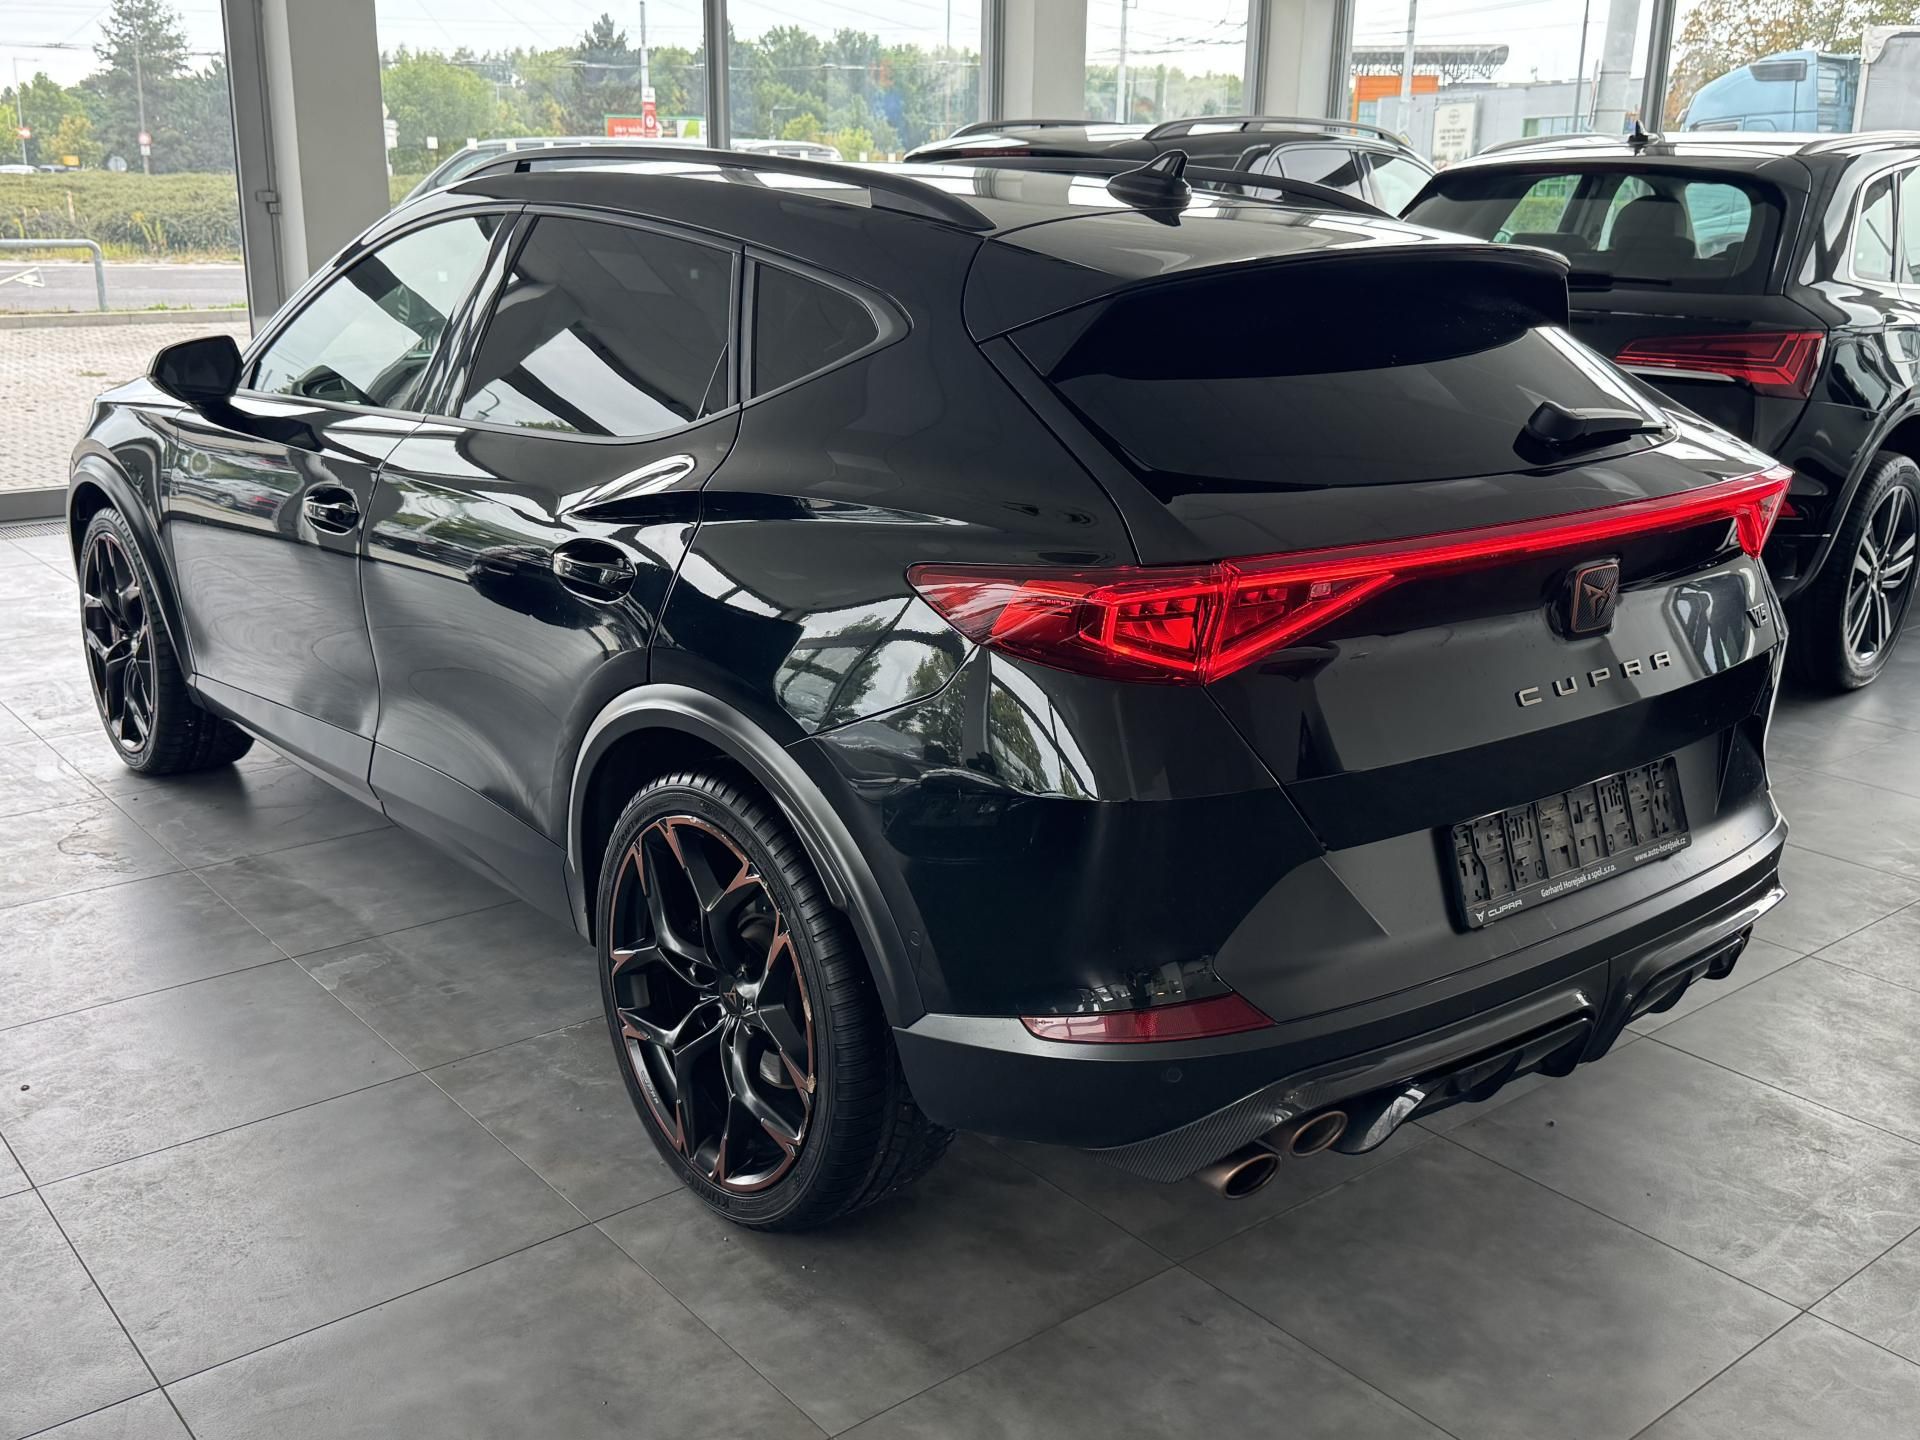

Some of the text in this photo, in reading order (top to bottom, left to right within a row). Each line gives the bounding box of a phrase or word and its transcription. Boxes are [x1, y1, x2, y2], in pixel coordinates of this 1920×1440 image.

[1515, 651, 1672, 708] CUPRA
[1540, 881, 1563, 898] Gerhard
[1563, 873, 1587, 889] Horejsek
[1487, 899, 1523, 917] CUPRA
